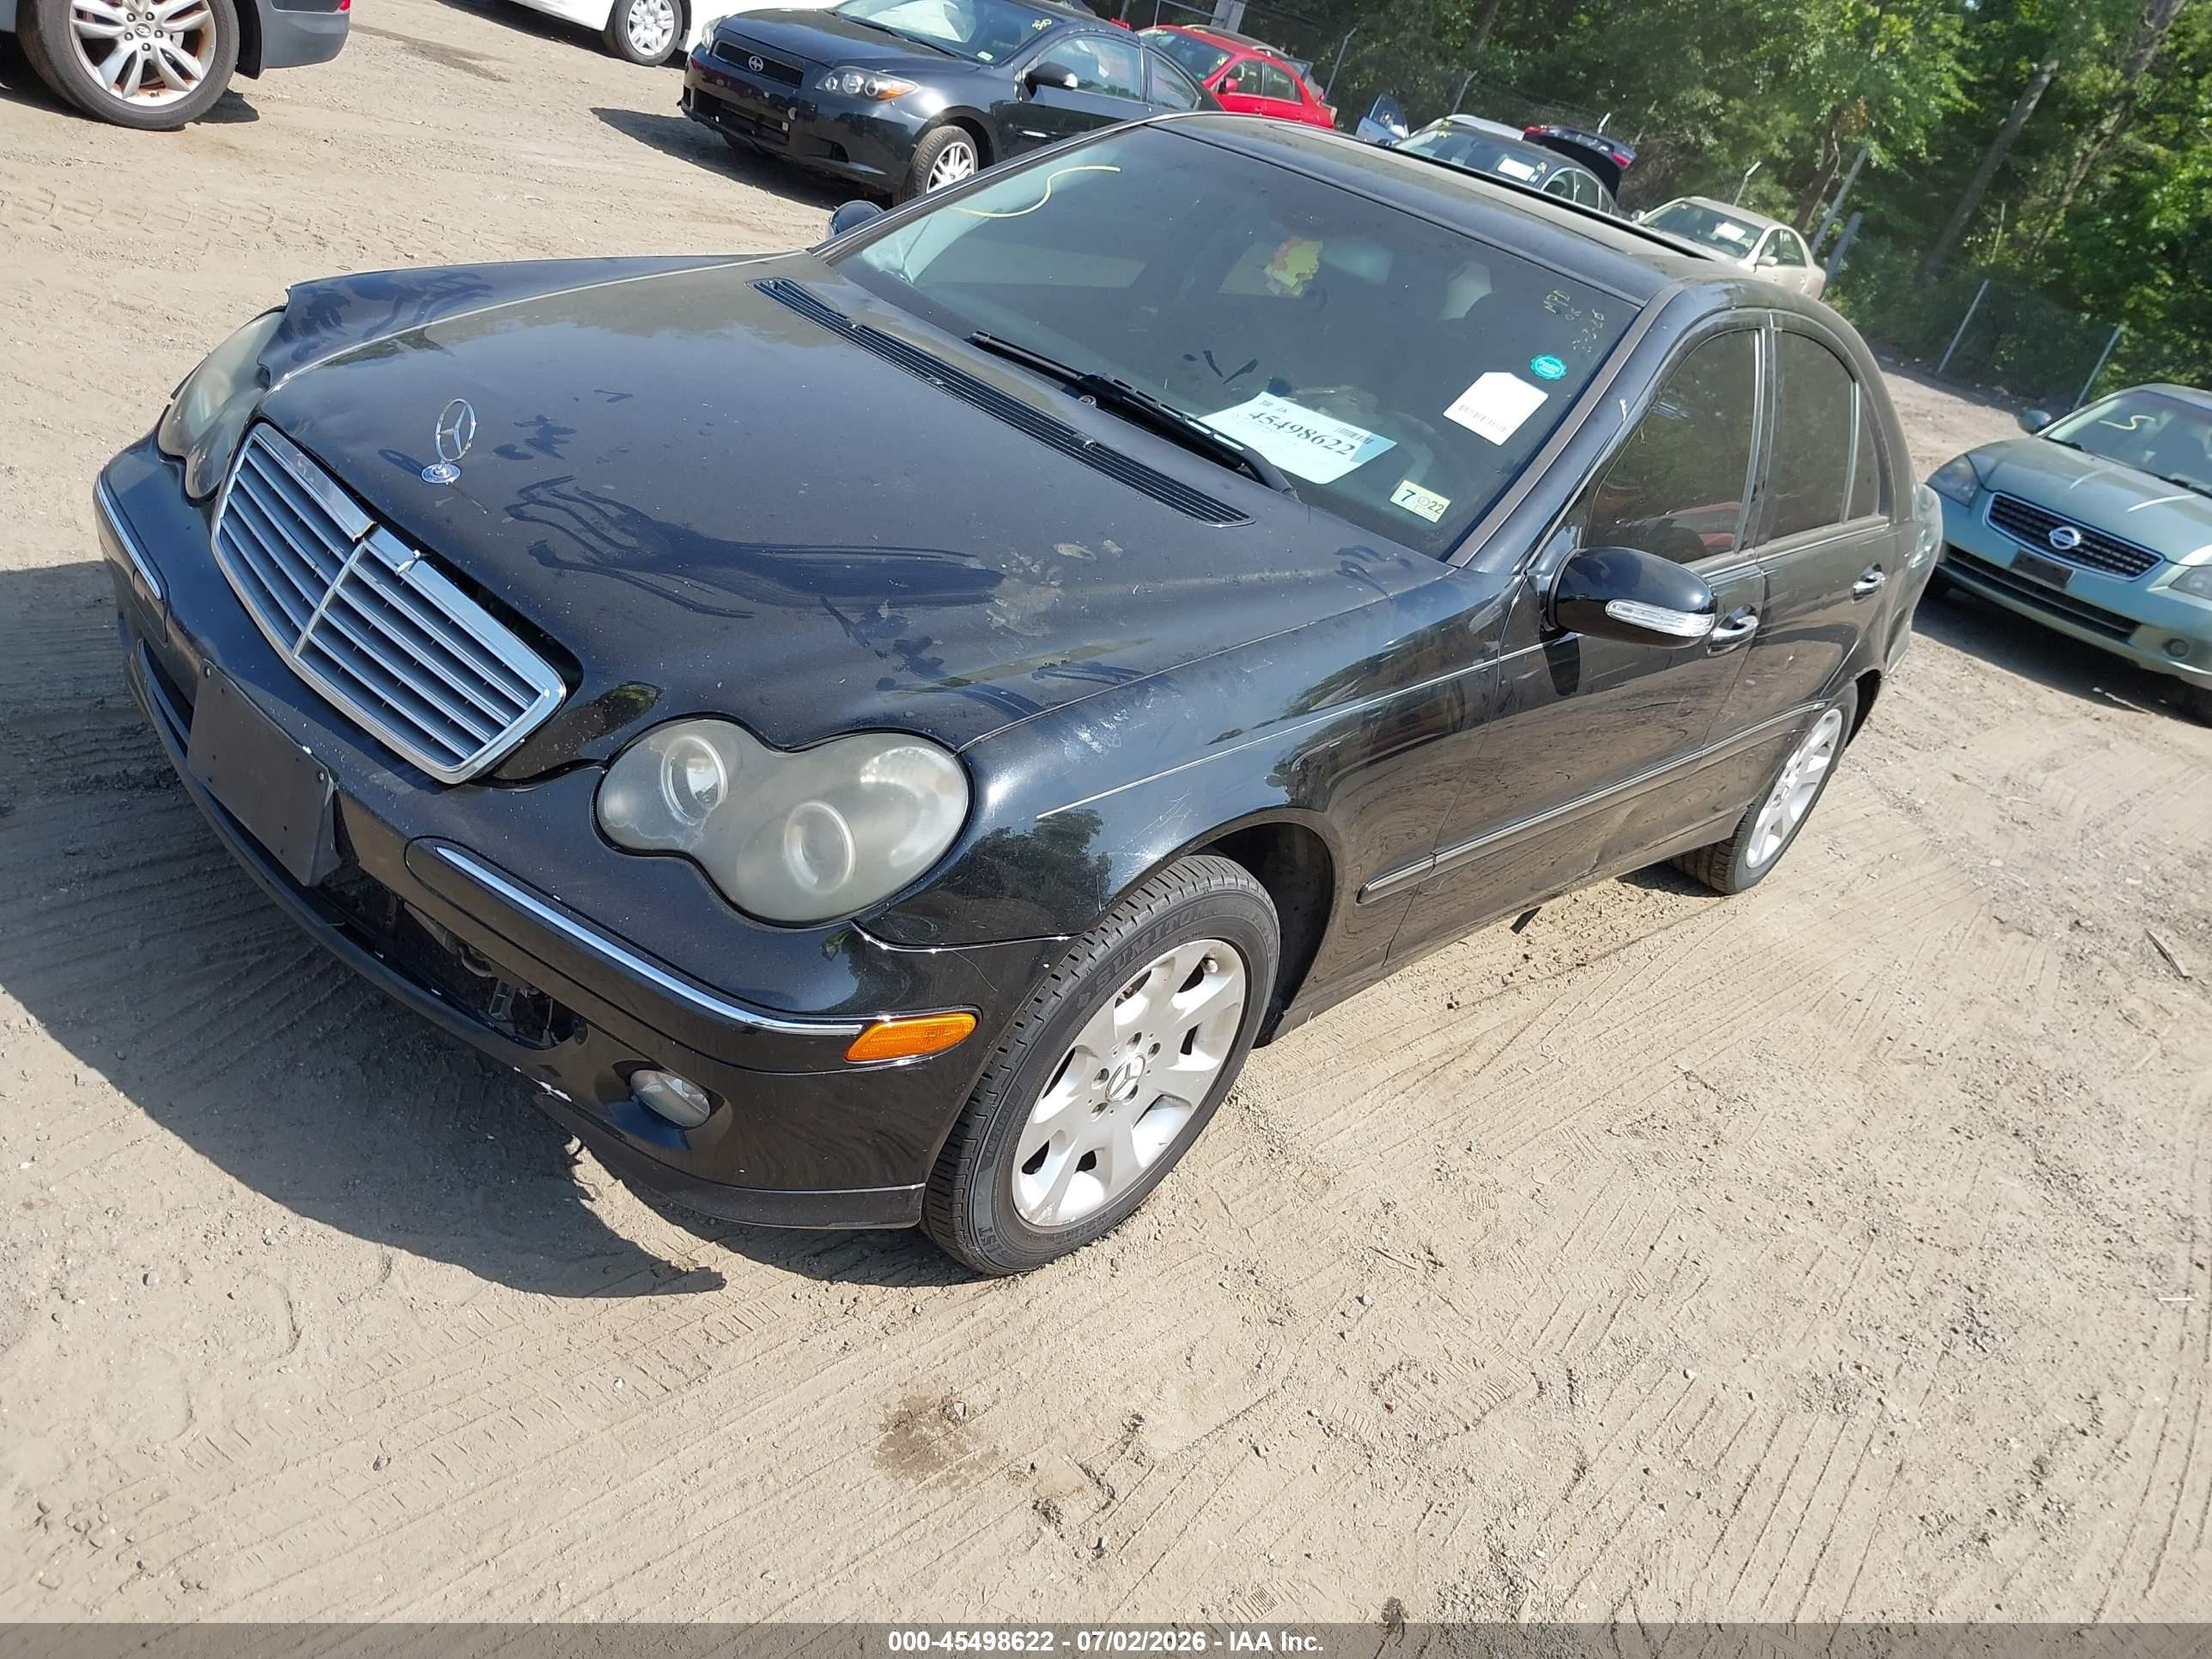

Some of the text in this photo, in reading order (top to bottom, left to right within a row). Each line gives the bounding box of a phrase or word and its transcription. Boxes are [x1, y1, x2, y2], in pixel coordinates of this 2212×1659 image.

[1249, 412, 1356, 455] 45498622
[1401, 489, 1444, 514] 7 22
